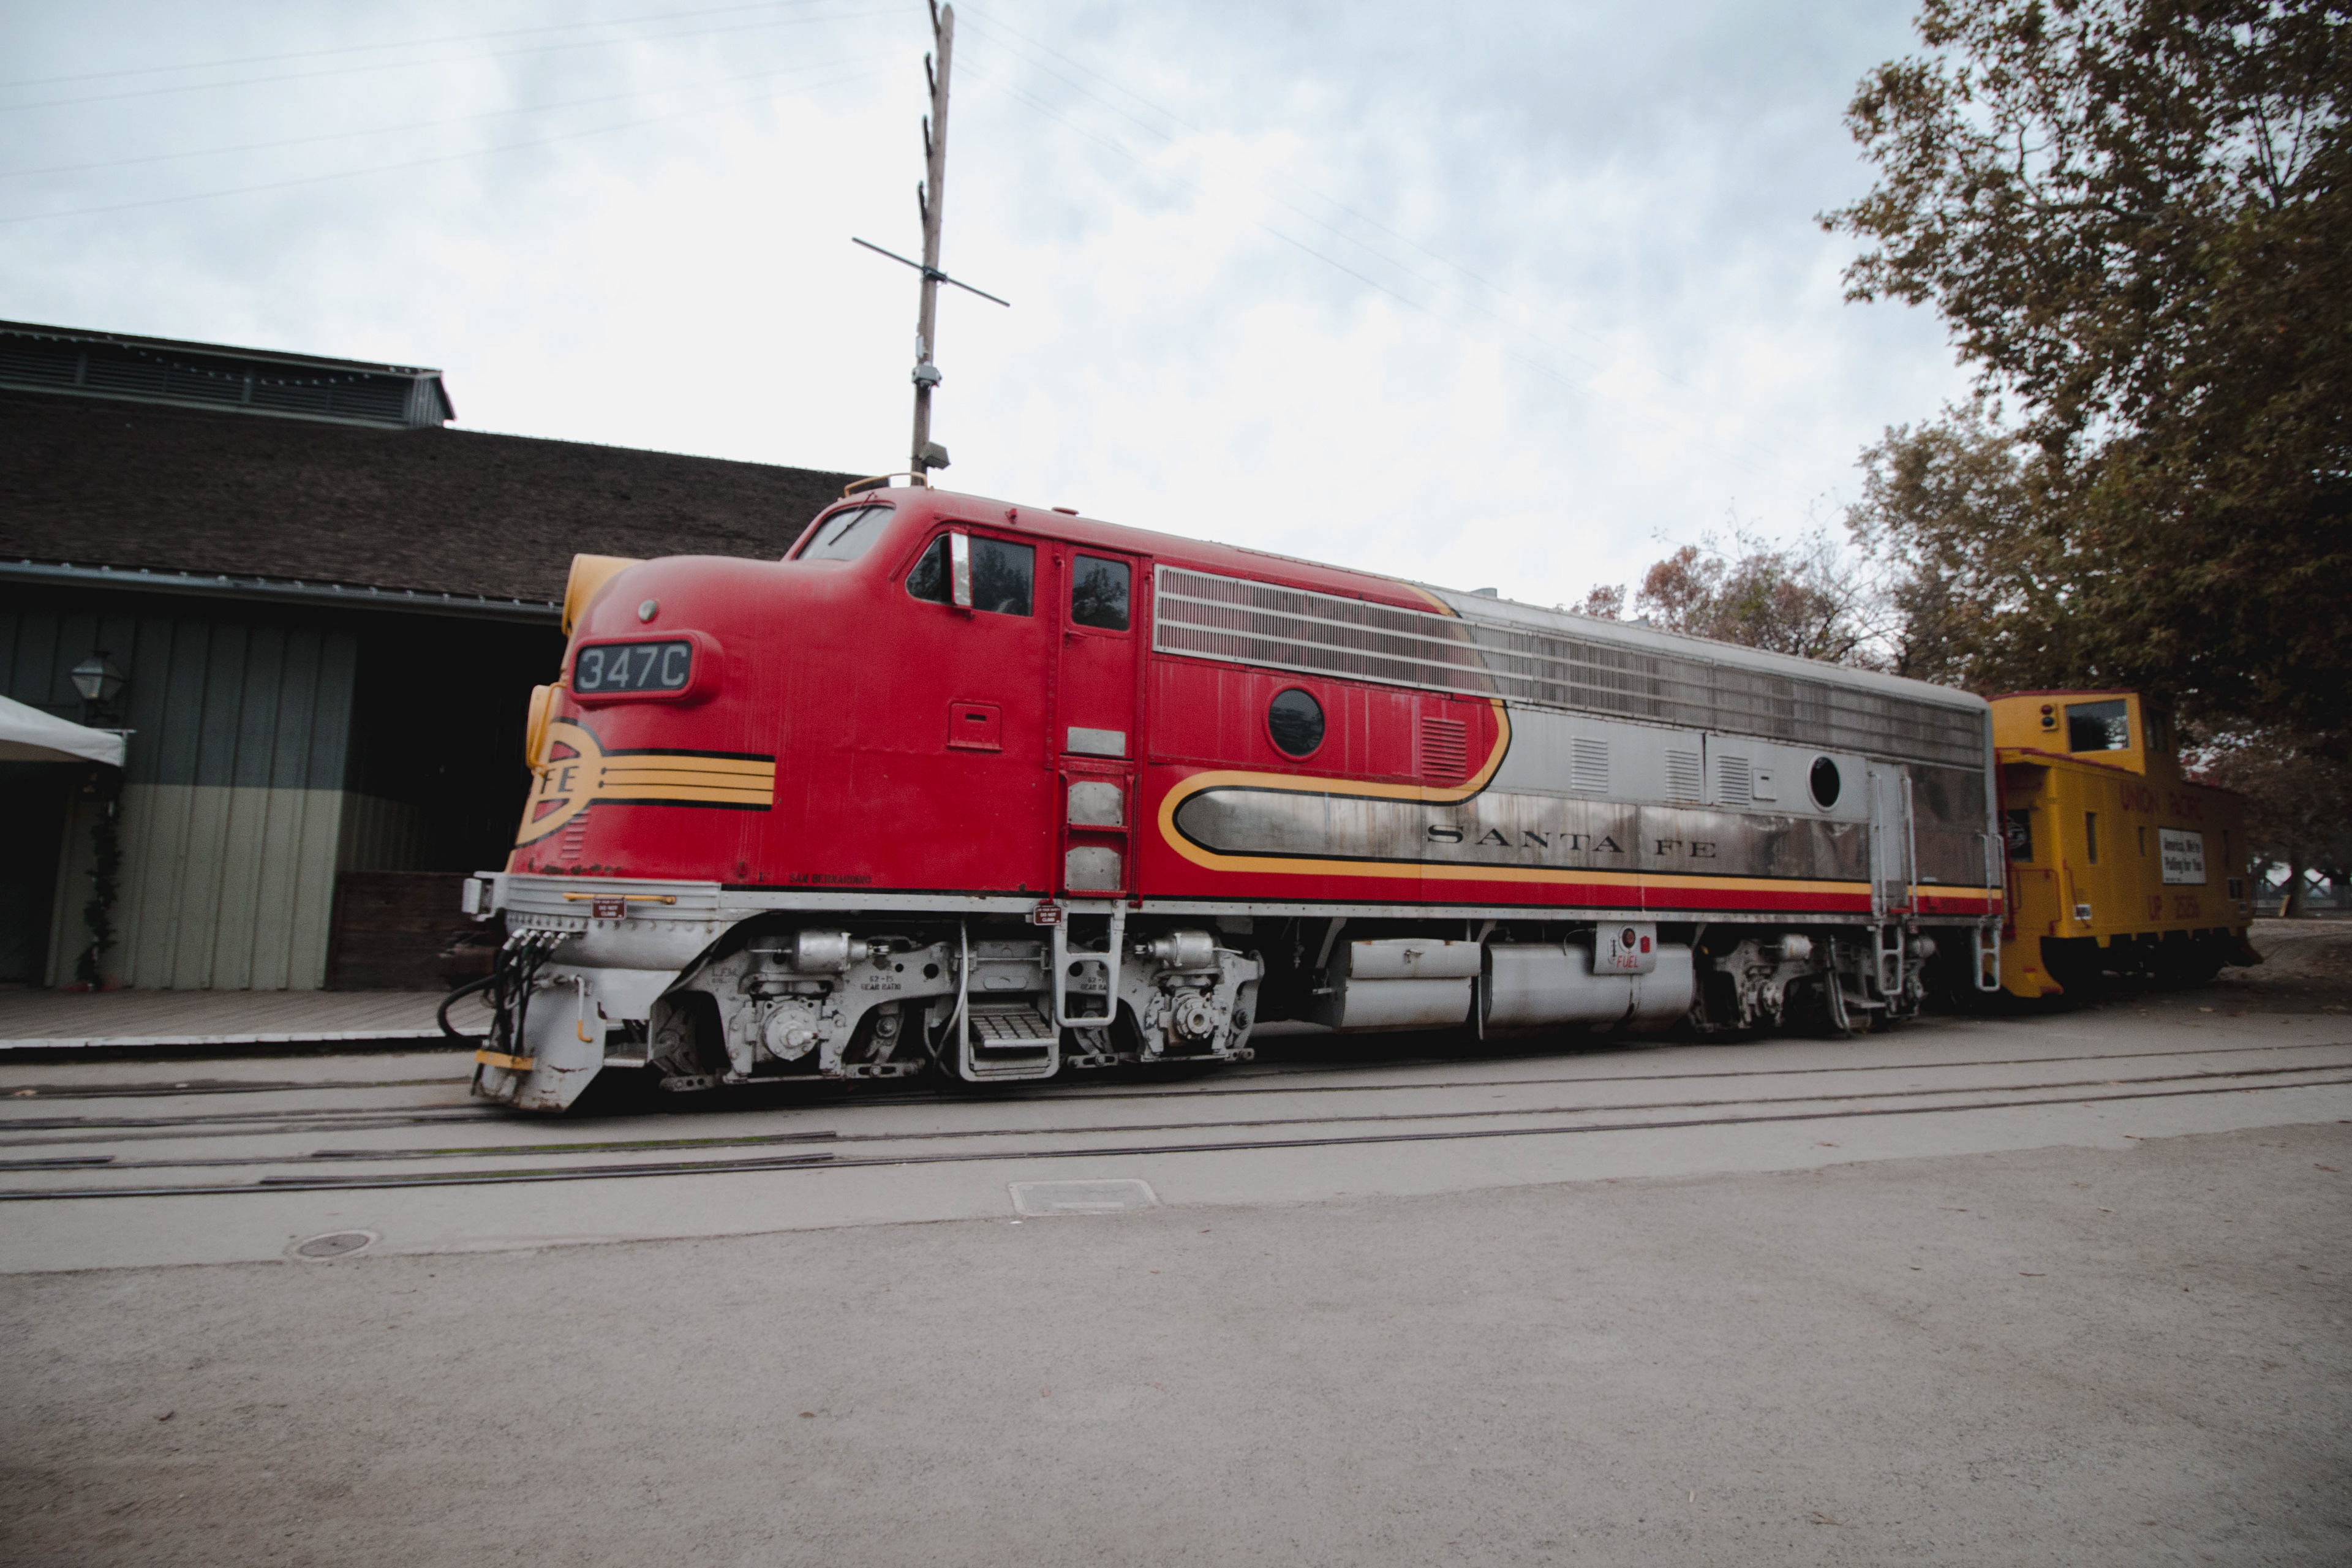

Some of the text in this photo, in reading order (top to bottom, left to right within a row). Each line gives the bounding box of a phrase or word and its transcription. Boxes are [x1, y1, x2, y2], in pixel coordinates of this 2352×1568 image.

[579, 645, 687, 689] 347C
[540, 766, 579, 794] FE
[1427, 824, 1716, 858] SANTA FE
[789, 872, 872, 884] SAN BERNARDINO
[1616, 955, 1638, 968] FUEL
